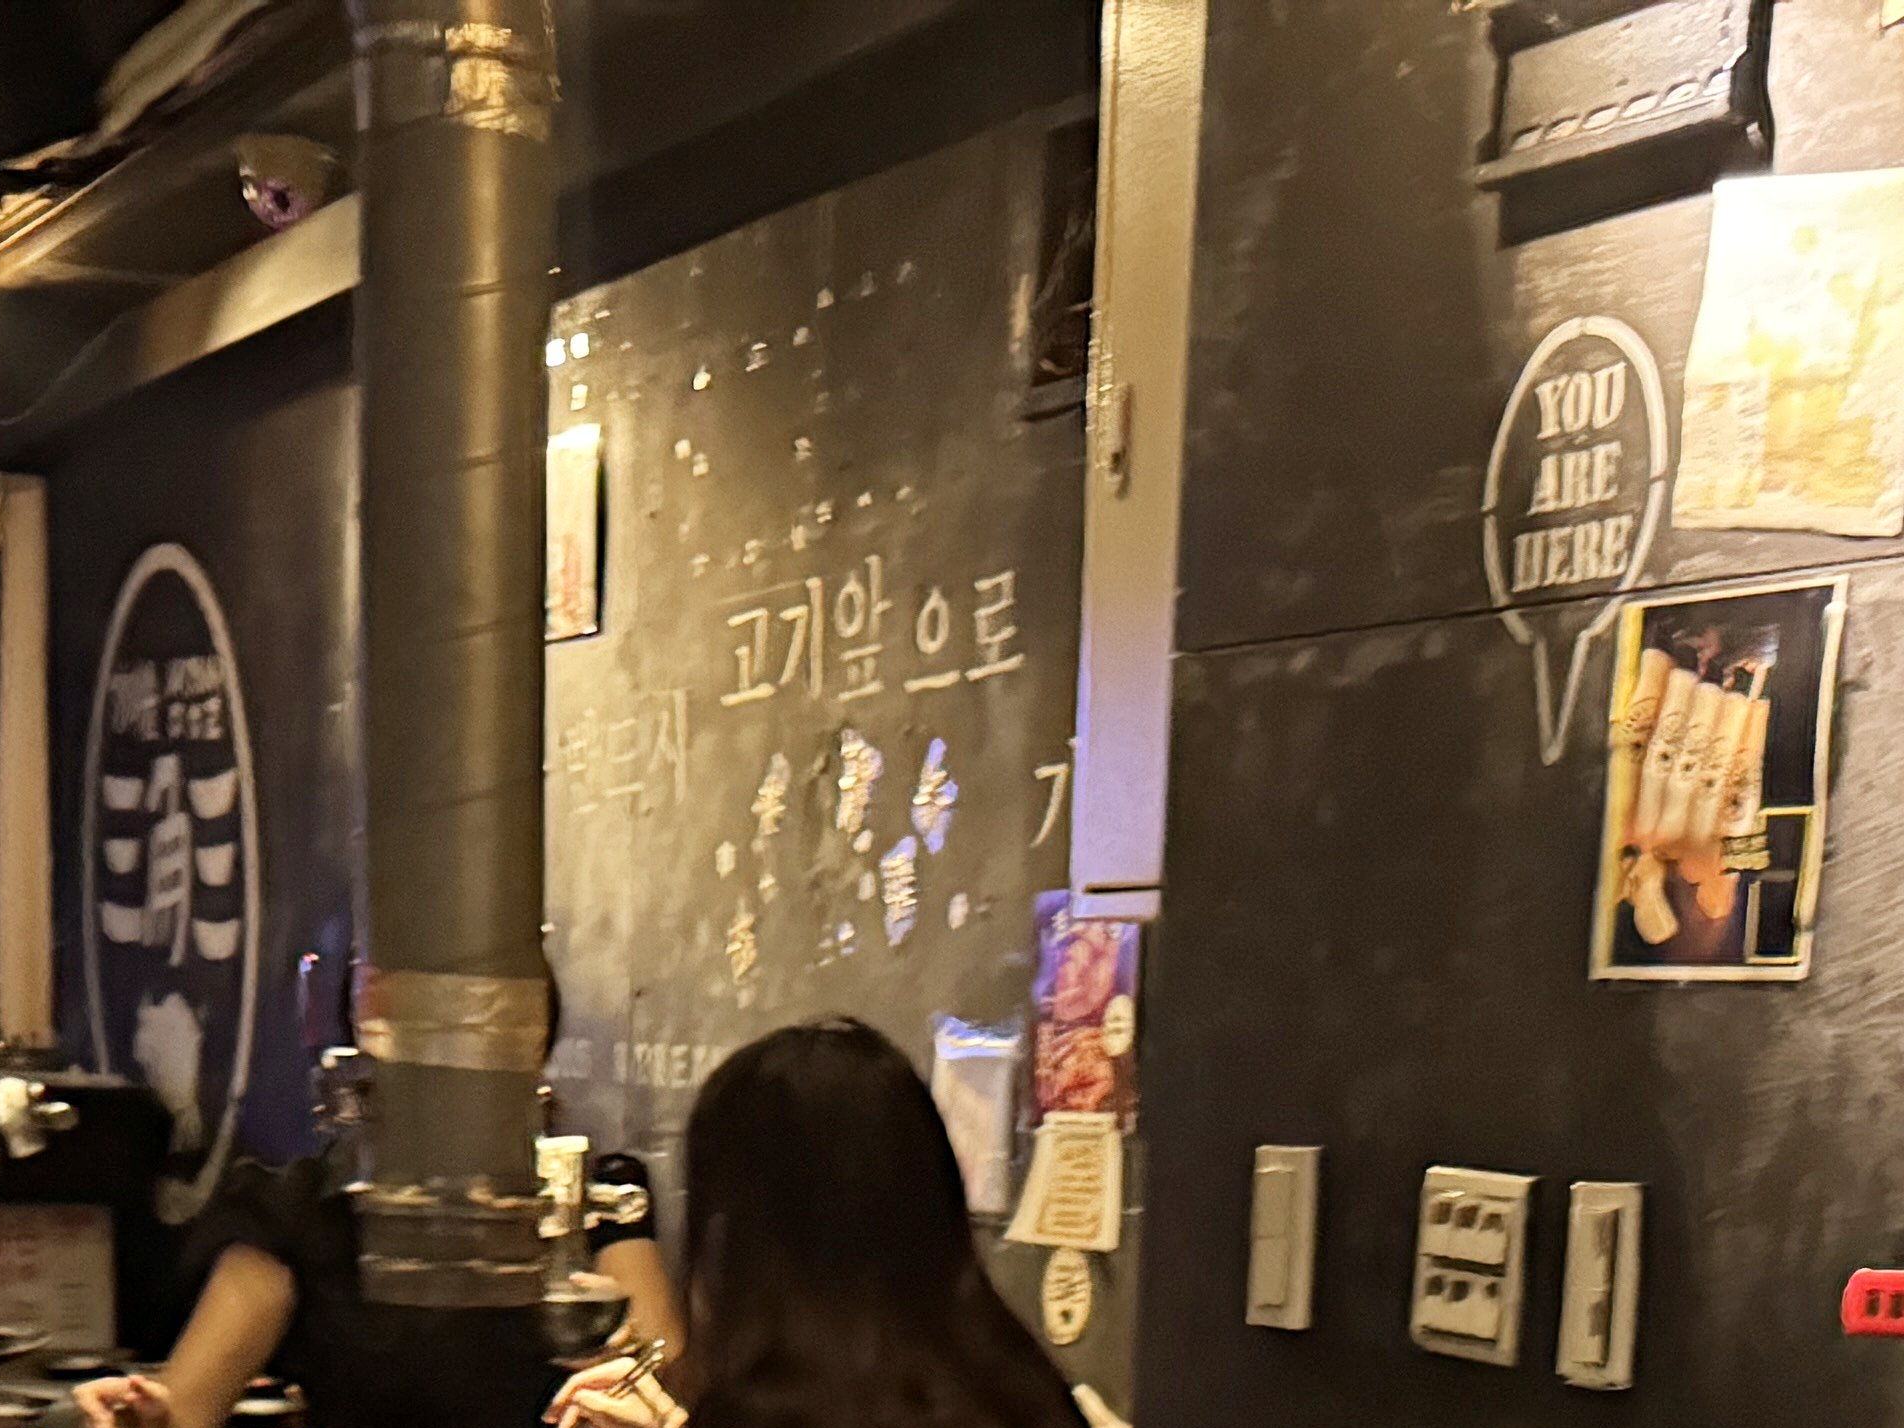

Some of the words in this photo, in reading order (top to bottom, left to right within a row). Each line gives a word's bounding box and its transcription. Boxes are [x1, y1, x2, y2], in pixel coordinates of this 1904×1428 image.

[1534, 360, 1628, 440] YOU
[1527, 440, 1623, 517] ARE
[1511, 514, 1635, 593] HERE
